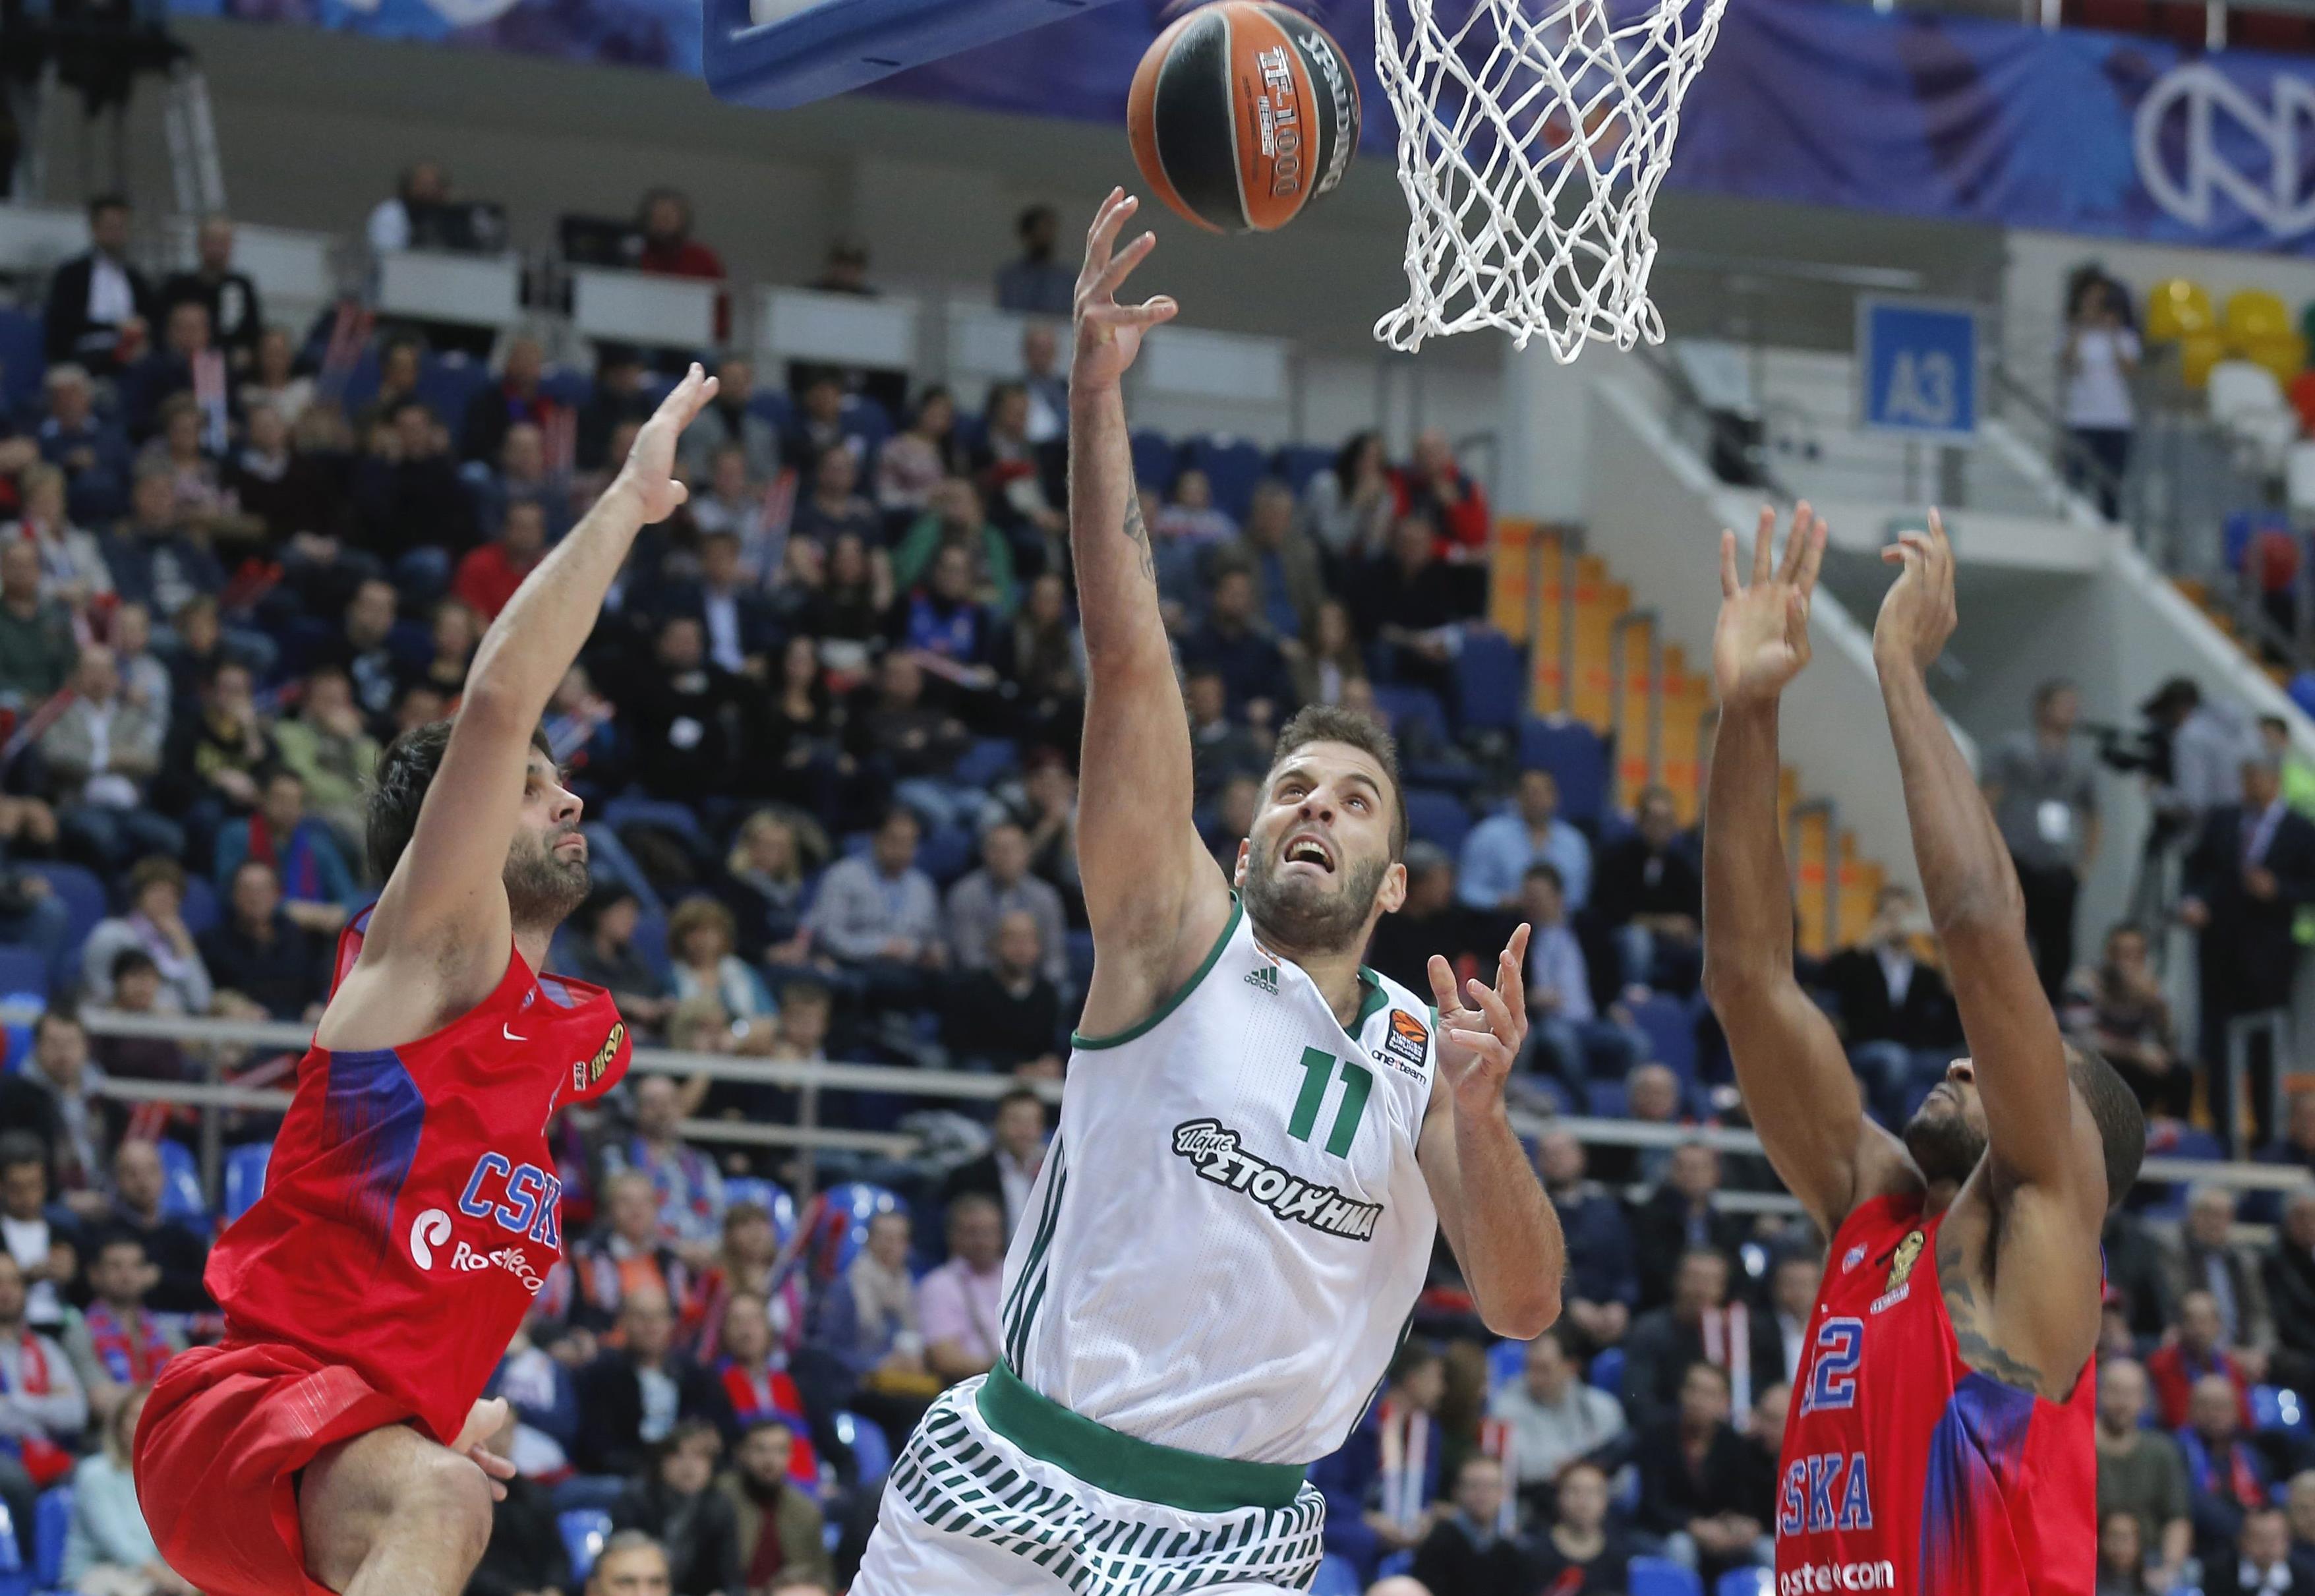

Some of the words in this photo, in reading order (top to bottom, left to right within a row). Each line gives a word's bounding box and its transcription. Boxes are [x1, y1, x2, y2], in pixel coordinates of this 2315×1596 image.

[1258, 45, 1299, 196] TF-1000
[1883, 350, 1956, 425] A3
[1244, 975, 1279, 995] adidas
[1287, 1046, 1373, 1160] 11
[459, 1151, 562, 1256] CSK
[1800, 1316, 1864, 1419] 2
[1776, 1452, 1873, 1539] SKA
